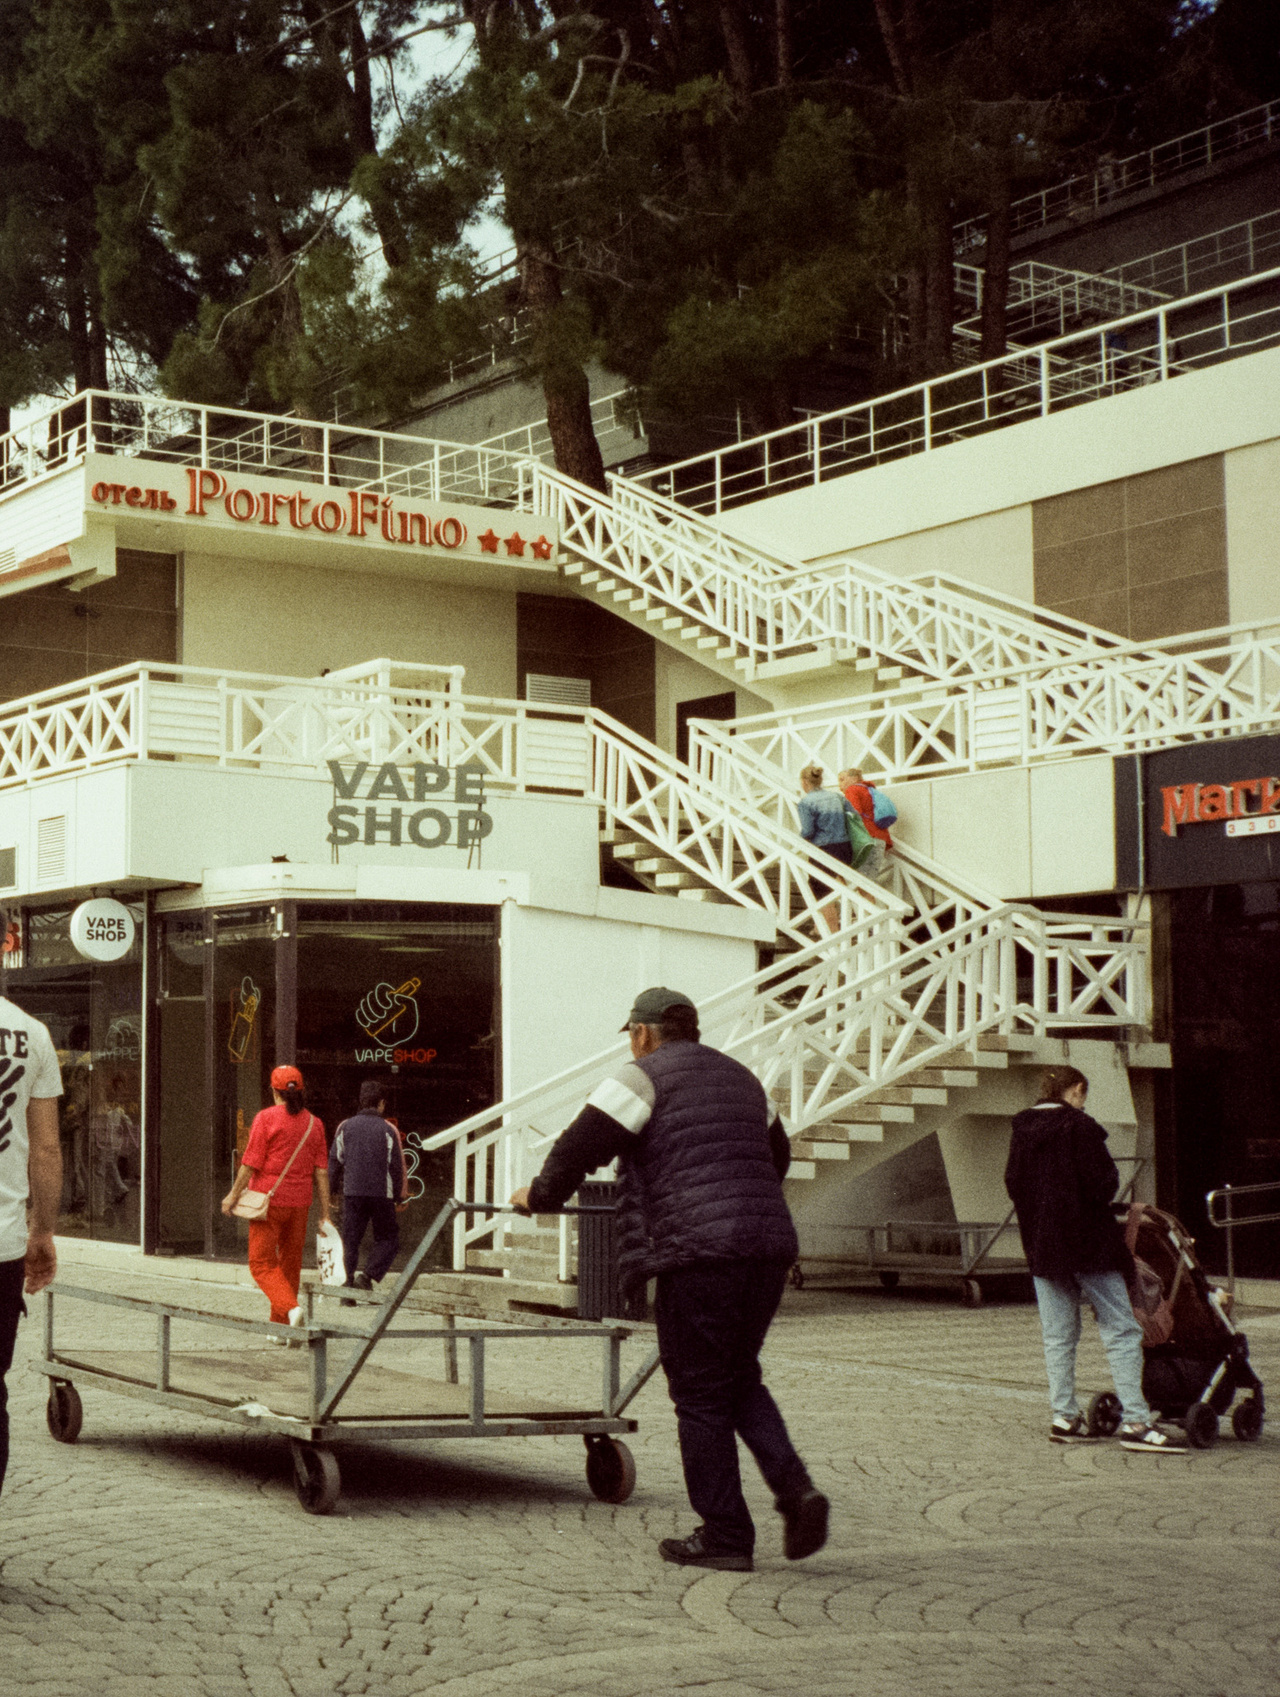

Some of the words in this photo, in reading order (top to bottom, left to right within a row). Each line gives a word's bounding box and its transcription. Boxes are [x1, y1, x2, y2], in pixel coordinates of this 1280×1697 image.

[91, 479, 178, 512] отель
[185, 468, 468, 549] PortoFino
[326, 760, 489, 804] VAPE
[326, 805, 493, 849] SHOP
[86, 916, 126, 930] VAPE
[86, 929, 127, 942] SHOP
